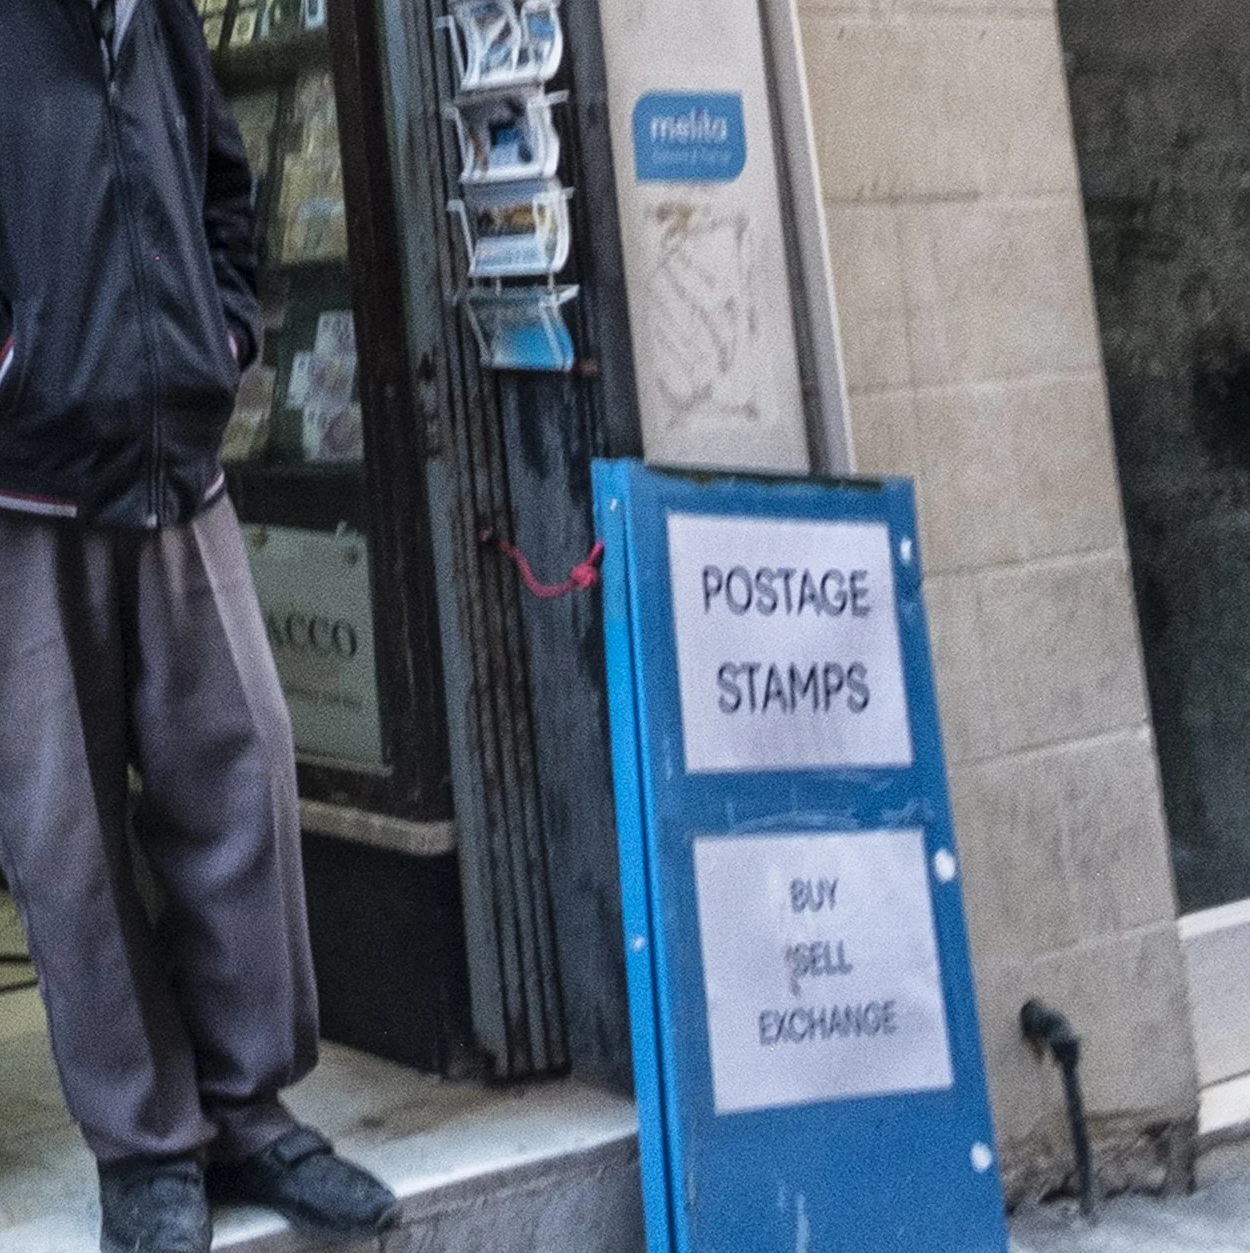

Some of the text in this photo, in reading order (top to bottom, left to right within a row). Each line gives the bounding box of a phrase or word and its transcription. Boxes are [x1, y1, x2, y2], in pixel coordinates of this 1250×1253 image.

[649, 106, 729, 145] melita
[702, 564, 871, 619] POSTAGE
[716, 659, 871, 716] STAMPS
[790, 877, 838, 914] BUY
[793, 941, 853, 977] SELL
[758, 1000, 899, 1047] EXCHANGE
